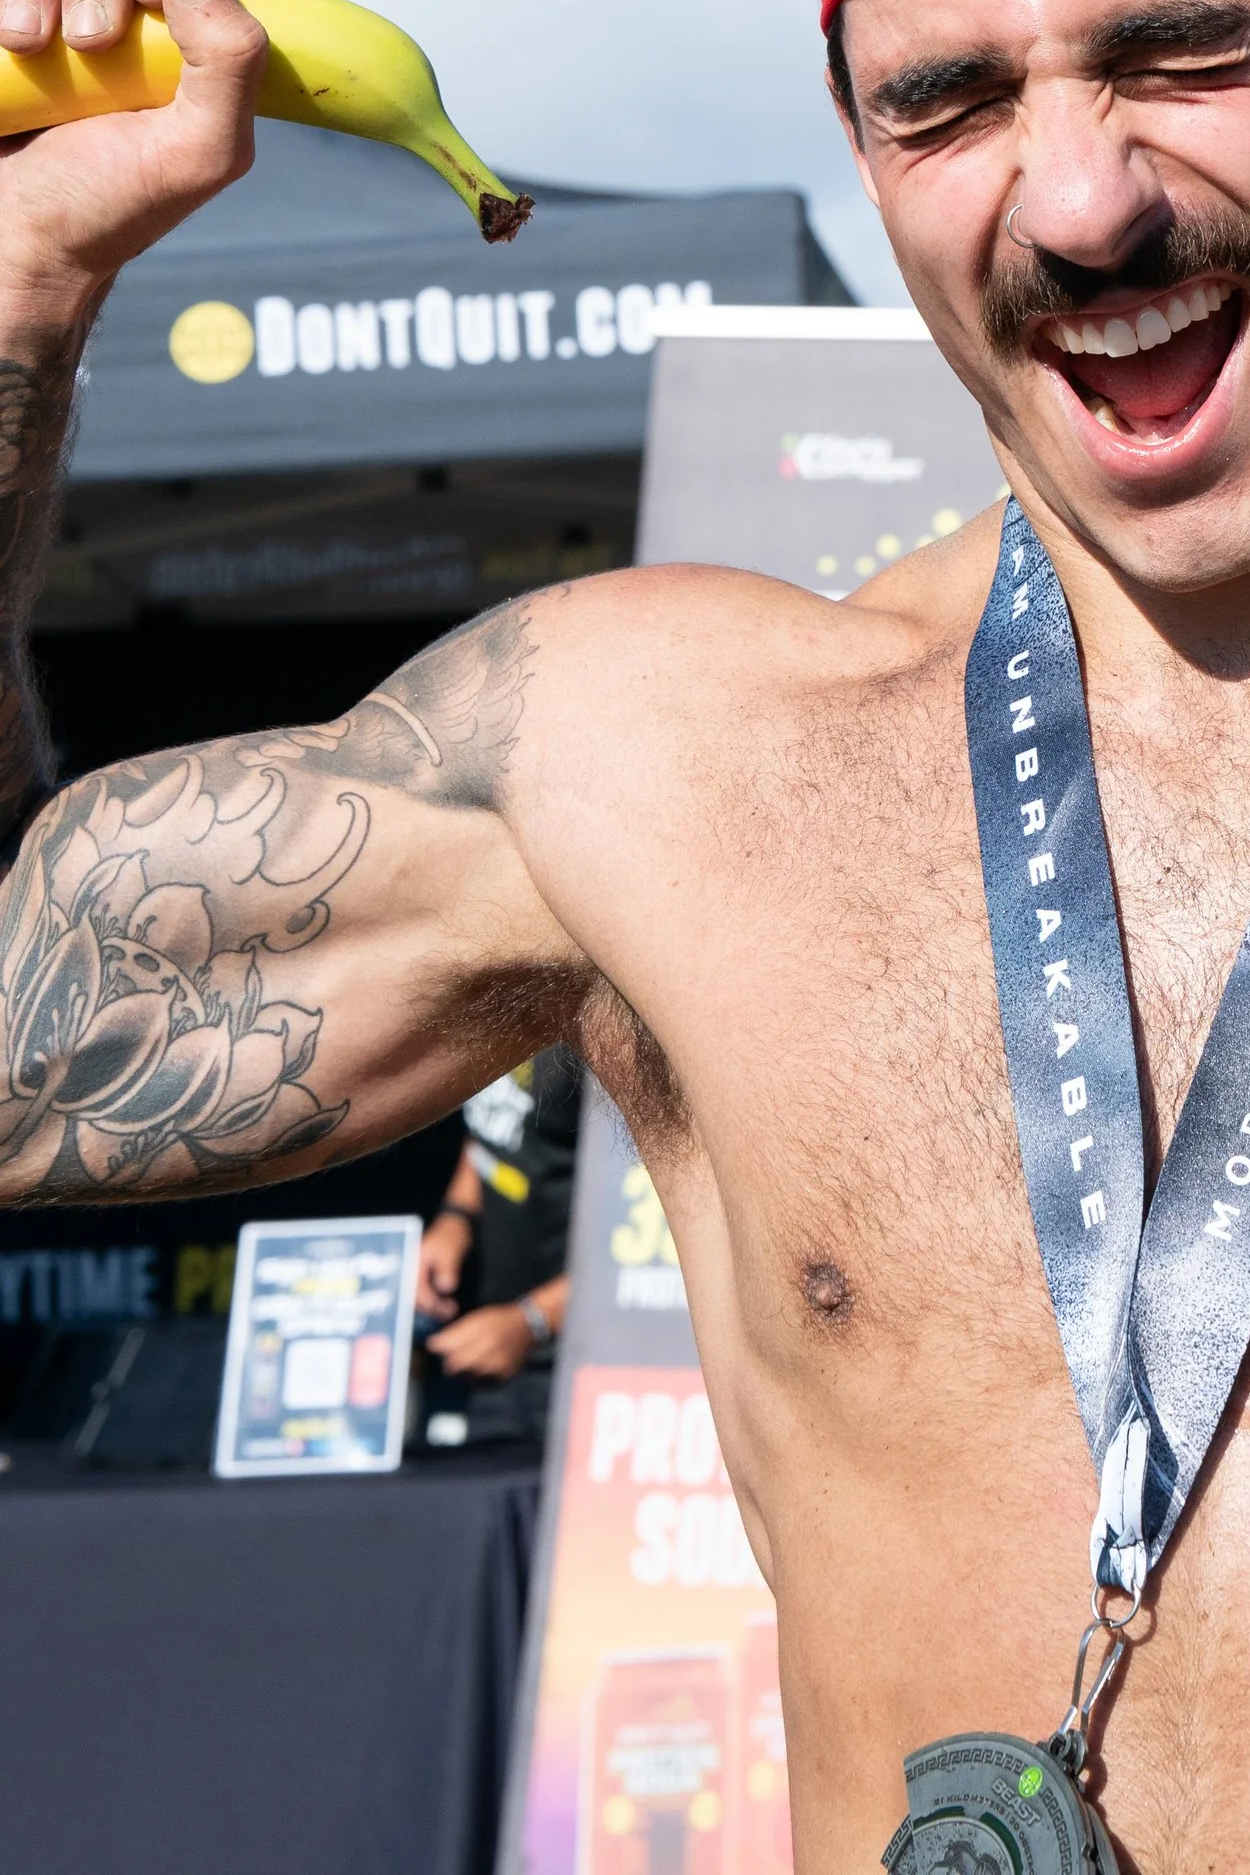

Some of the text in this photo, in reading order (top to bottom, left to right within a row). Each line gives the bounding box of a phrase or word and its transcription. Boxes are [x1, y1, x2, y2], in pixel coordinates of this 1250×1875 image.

[1007, 650, 1106, 1229] UNBREAKABLE
[588, 1391, 733, 1486] PRO
[629, 1491, 768, 1590] SOD
[991, 1777, 1041, 1828] BEAST
